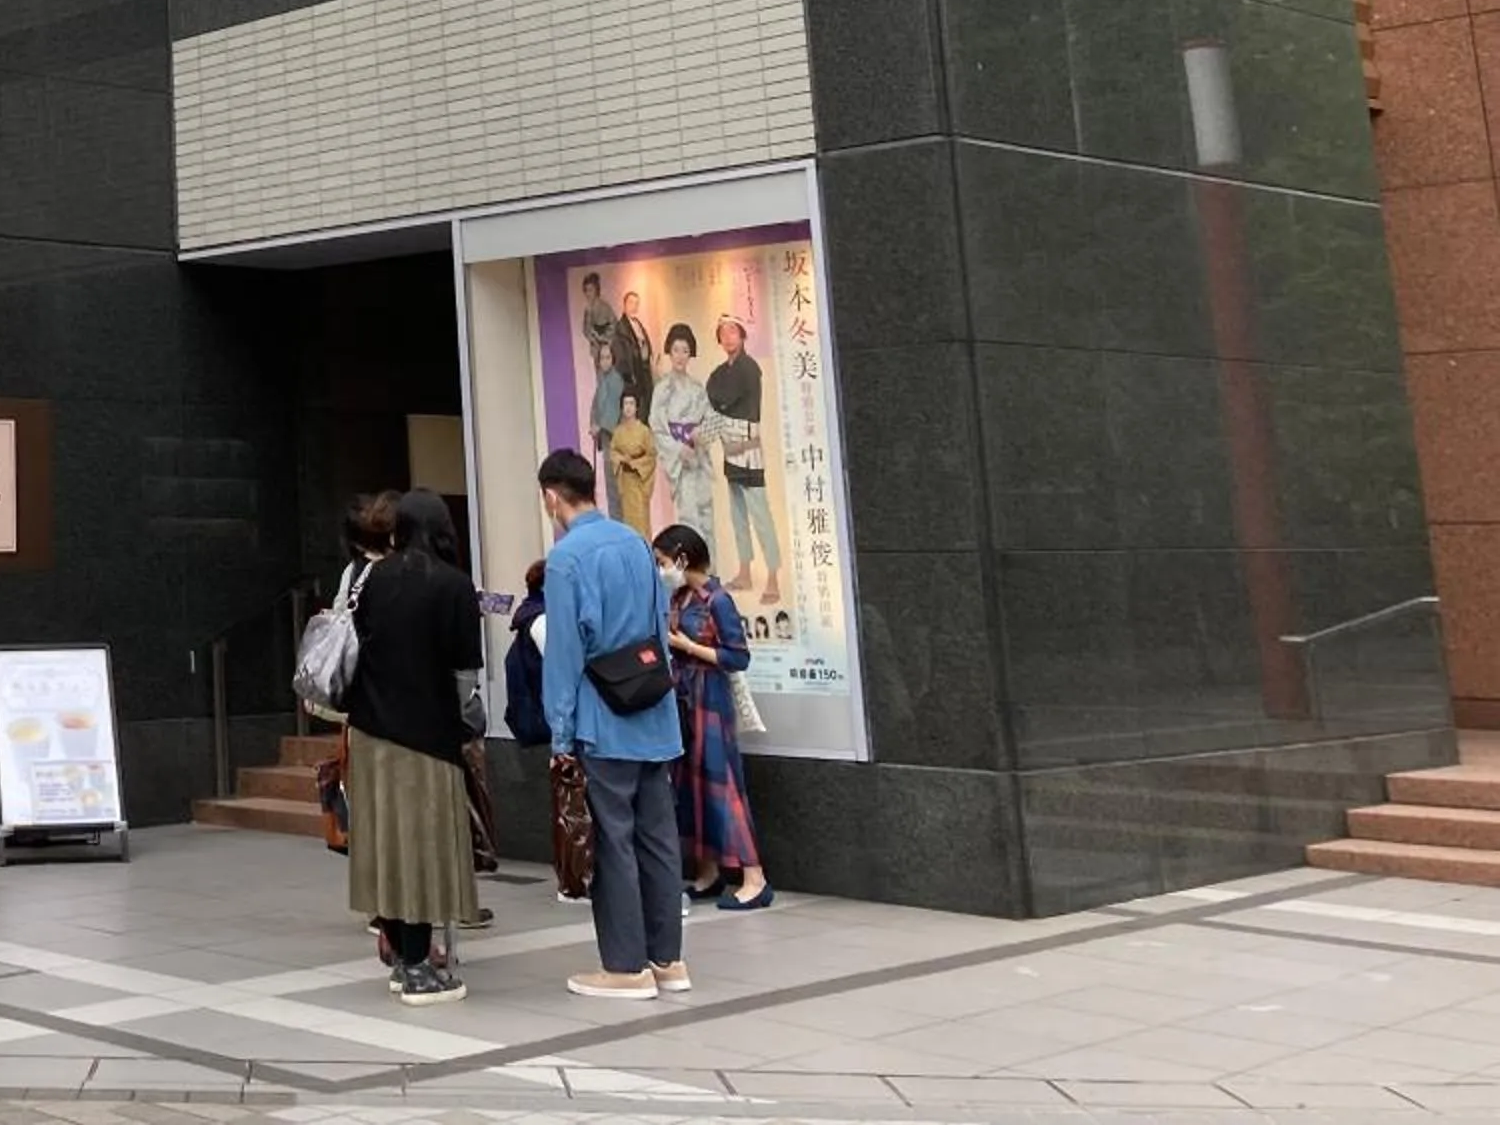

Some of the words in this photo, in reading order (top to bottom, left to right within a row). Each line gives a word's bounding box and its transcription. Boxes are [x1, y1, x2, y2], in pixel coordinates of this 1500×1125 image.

[783, 250, 818, 381] 坂本冬美
[802, 443, 833, 567] 中村雅俊
